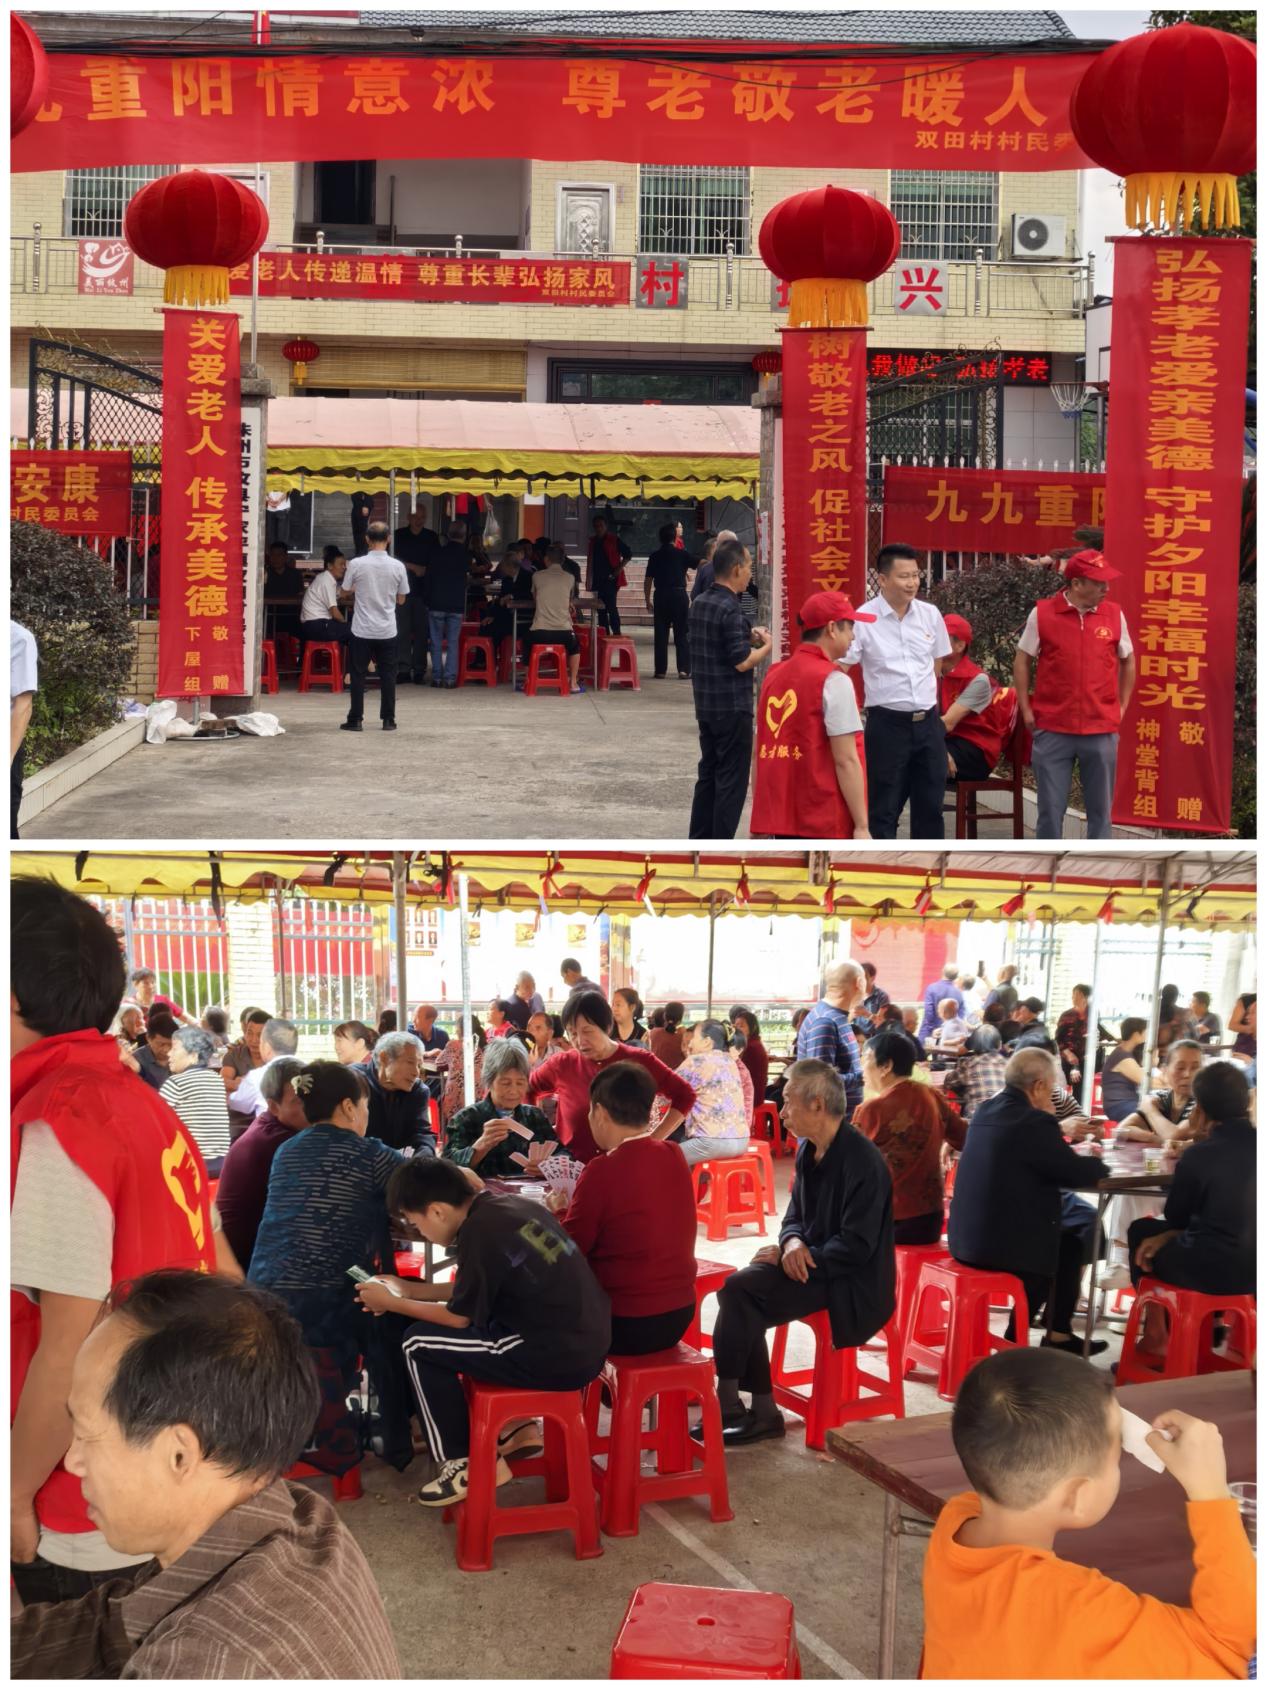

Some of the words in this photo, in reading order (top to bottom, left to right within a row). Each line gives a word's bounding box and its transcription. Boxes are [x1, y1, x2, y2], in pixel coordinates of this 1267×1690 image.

[35, 58, 495, 121] 重阳情意浓
[562, 60, 1048, 126] 尊老敬老暖人
[418, 262, 615, 289] 尊重长辈弘扬家风
[639, 261, 684, 306] 村
[900, 266, 943, 310] 兴
[186, 319, 226, 456] 关爱老人
[808, 334, 853, 472] 树敬老之风
[1145, 250, 1223, 471] 弘扬孝老爱亲美德
[14, 463, 100, 503] 安康
[185, 477, 228, 617] 传承美德
[1138, 486, 1213, 711] 守护夕阳幸福时光
[184, 626, 201, 691] 下屋组
[212, 625, 229, 690] 敬赠
[1133, 718, 1161, 818] 神堂背组
[1176, 721, 1205, 821] 敬赠
